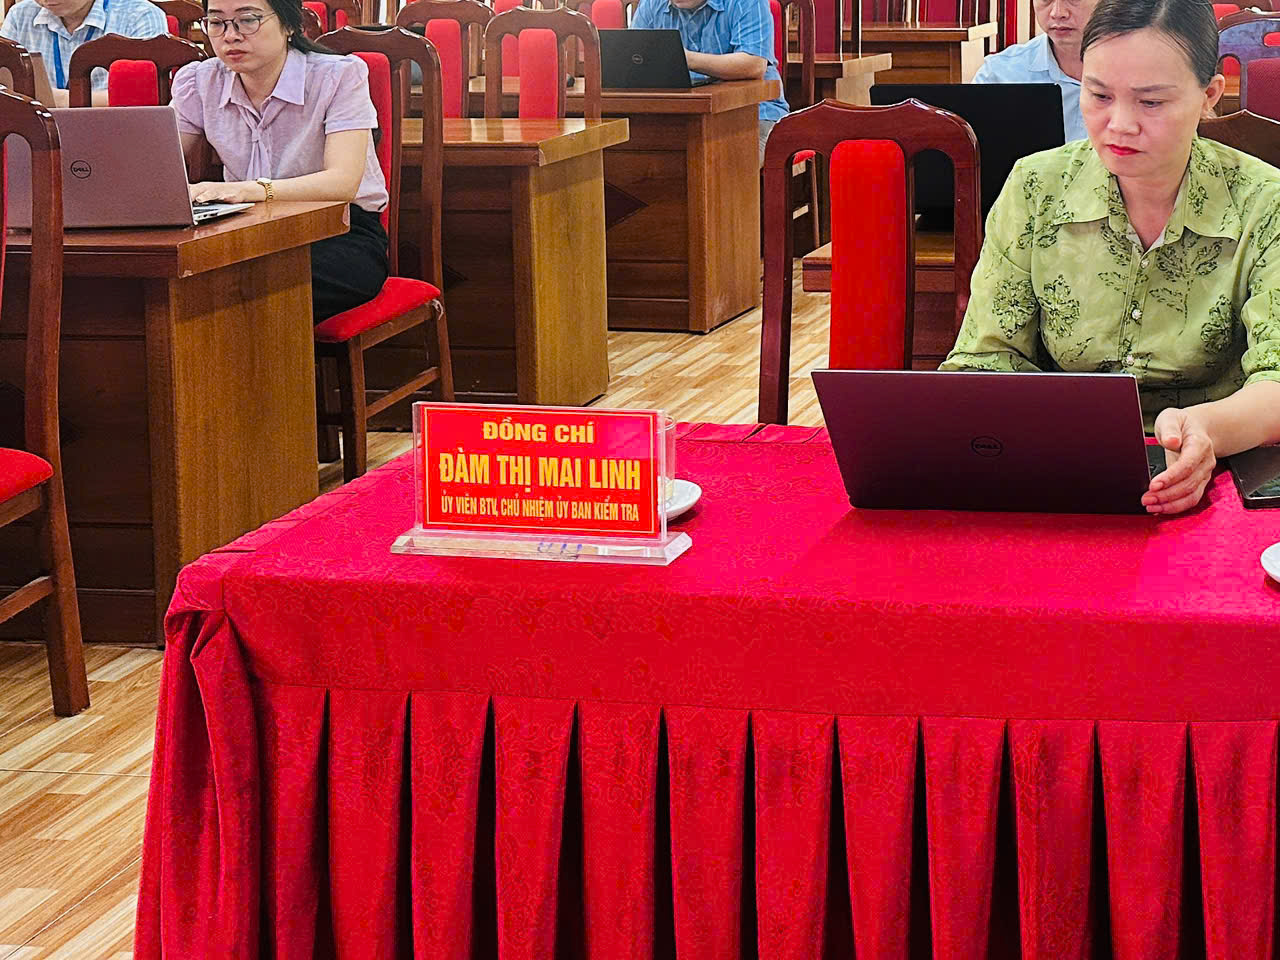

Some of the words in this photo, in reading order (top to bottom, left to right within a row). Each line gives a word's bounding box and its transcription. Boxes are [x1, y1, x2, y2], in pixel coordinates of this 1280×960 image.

[483, 416, 547, 443] ĐỒNG
[554, 421, 594, 444] CHÍ
[439, 447, 490, 485] ĐÀM
[496, 453, 532, 493] THỊ
[538, 457, 582, 488] MAI
[589, 459, 641, 490] LINH
[441, 489, 454, 514] ỦY
[456, 493, 478, 515] VIÊN
[501, 492, 520, 517] CHỦ
[522, 496, 554, 522] NHIỆM
[571, 501, 592, 520] BAN
[594, 495, 619, 521] KIỂM
[621, 503, 640, 522] TRA
